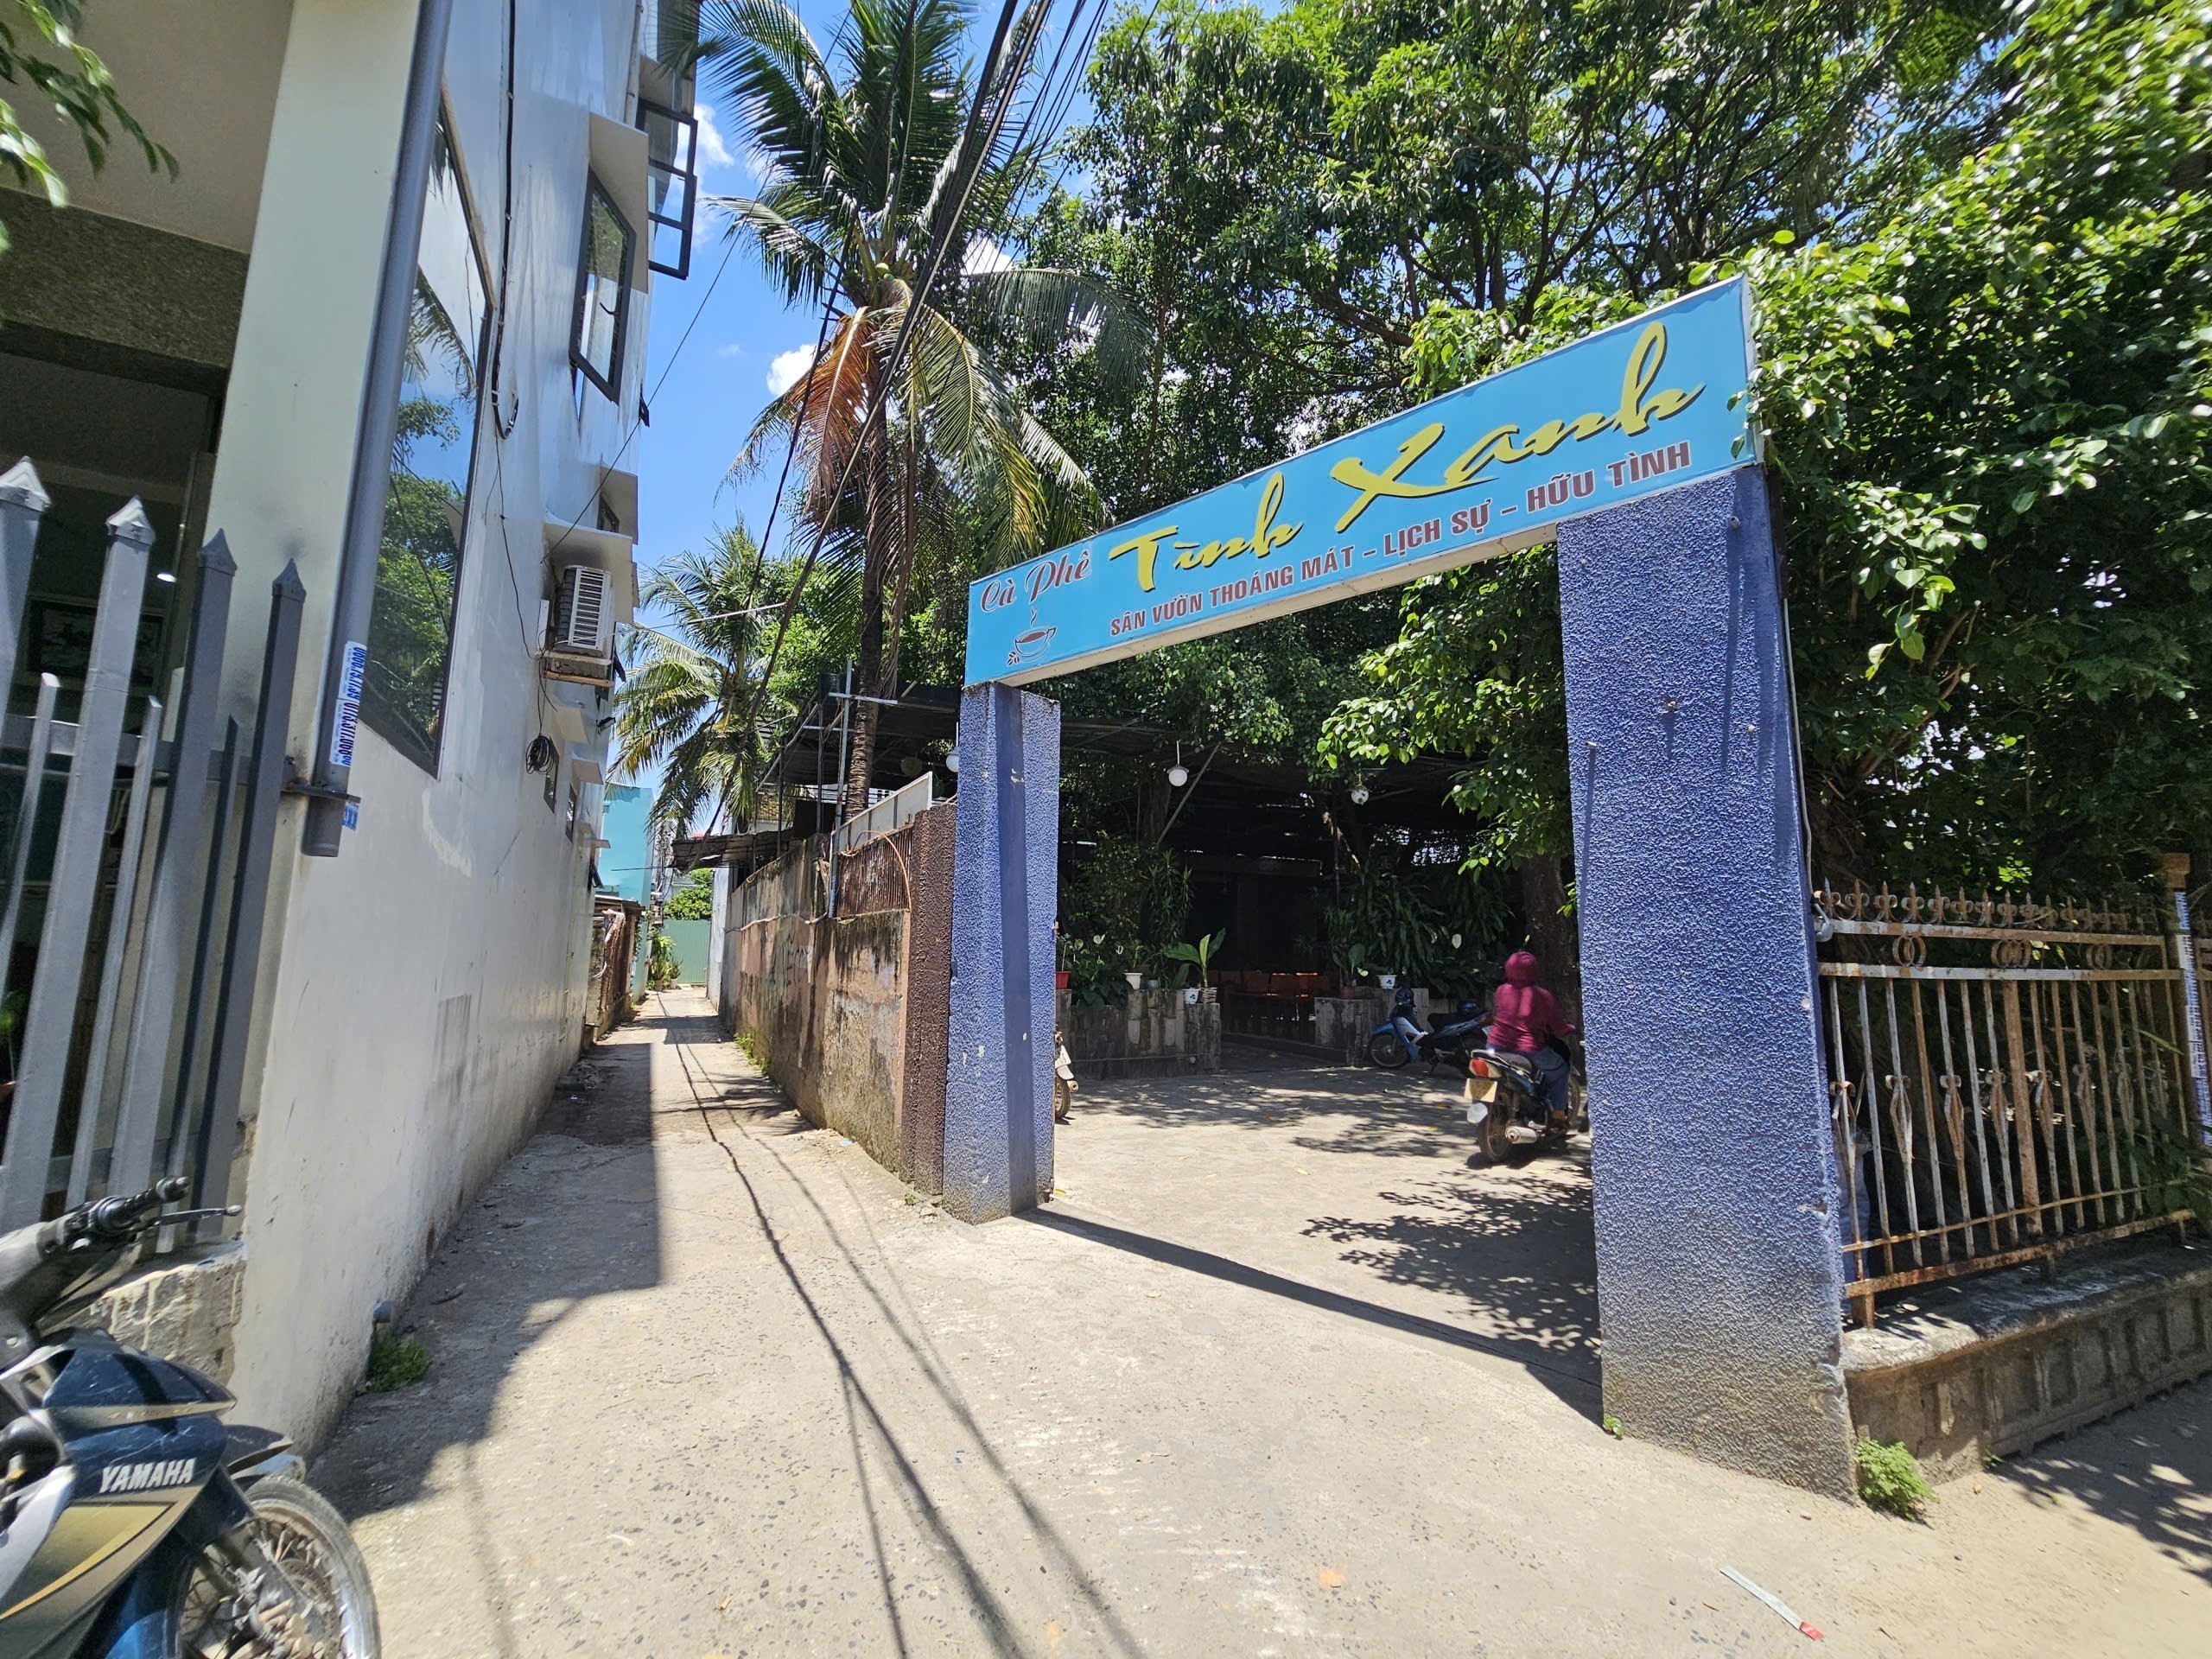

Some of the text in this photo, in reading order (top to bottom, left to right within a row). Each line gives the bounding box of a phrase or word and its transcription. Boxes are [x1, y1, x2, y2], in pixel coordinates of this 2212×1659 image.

[1109, 321, 1707, 593] Tình Xanh
[980, 548, 1093, 613] Cà Phê
[1110, 610, 1147, 636] SÂN
[1153, 592, 1203, 624] VƯỜN
[1209, 565, 1294, 607] THOÁNG
[1301, 545, 1356, 582] MÁT
[1384, 518, 1442, 556] LỊCH
[1451, 498, 1492, 535] SỰ
[1526, 470, 1596, 512] HỮU
[1607, 440, 1693, 488] TÌNH
[99, 1458, 197, 1493] YAMAHA
